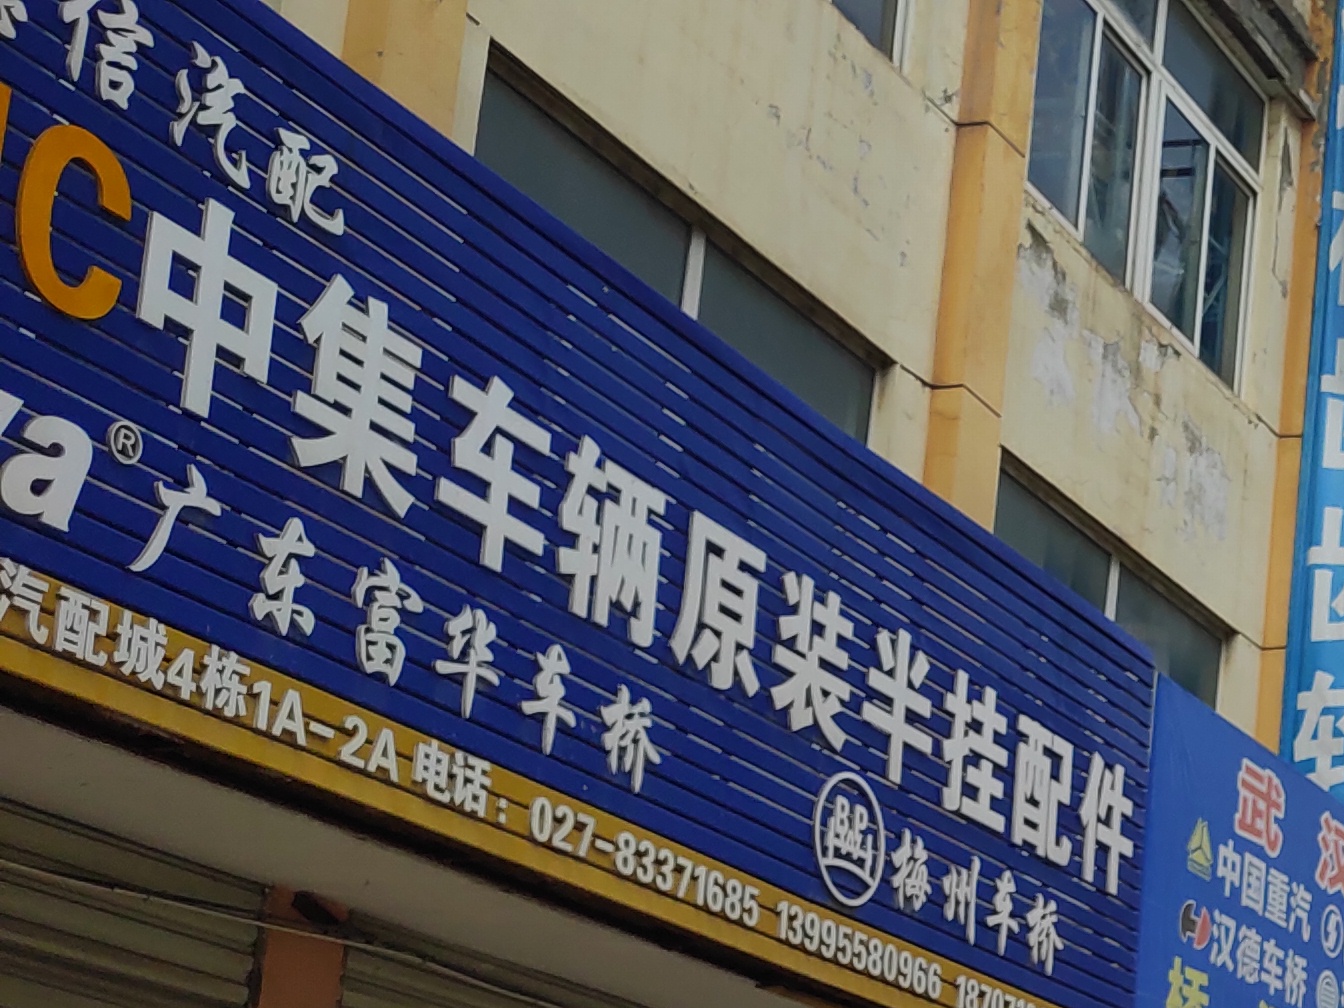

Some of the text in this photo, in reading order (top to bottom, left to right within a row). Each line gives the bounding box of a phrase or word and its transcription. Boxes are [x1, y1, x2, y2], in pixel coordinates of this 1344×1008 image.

[0, 0, 345, 236] 信汽配
[0, 84, 1135, 896] C 中集车辆原装半挂配件
[0, 398, 661, 794] a 广东富华车桥
[0, 558, 400, 783] 汽配城4栋1A-2A
[775, 900, 943, 998] 13995580966
[889, 827, 1065, 977] 梅州车桥
[1216, 839, 1313, 944] 中国重汽
